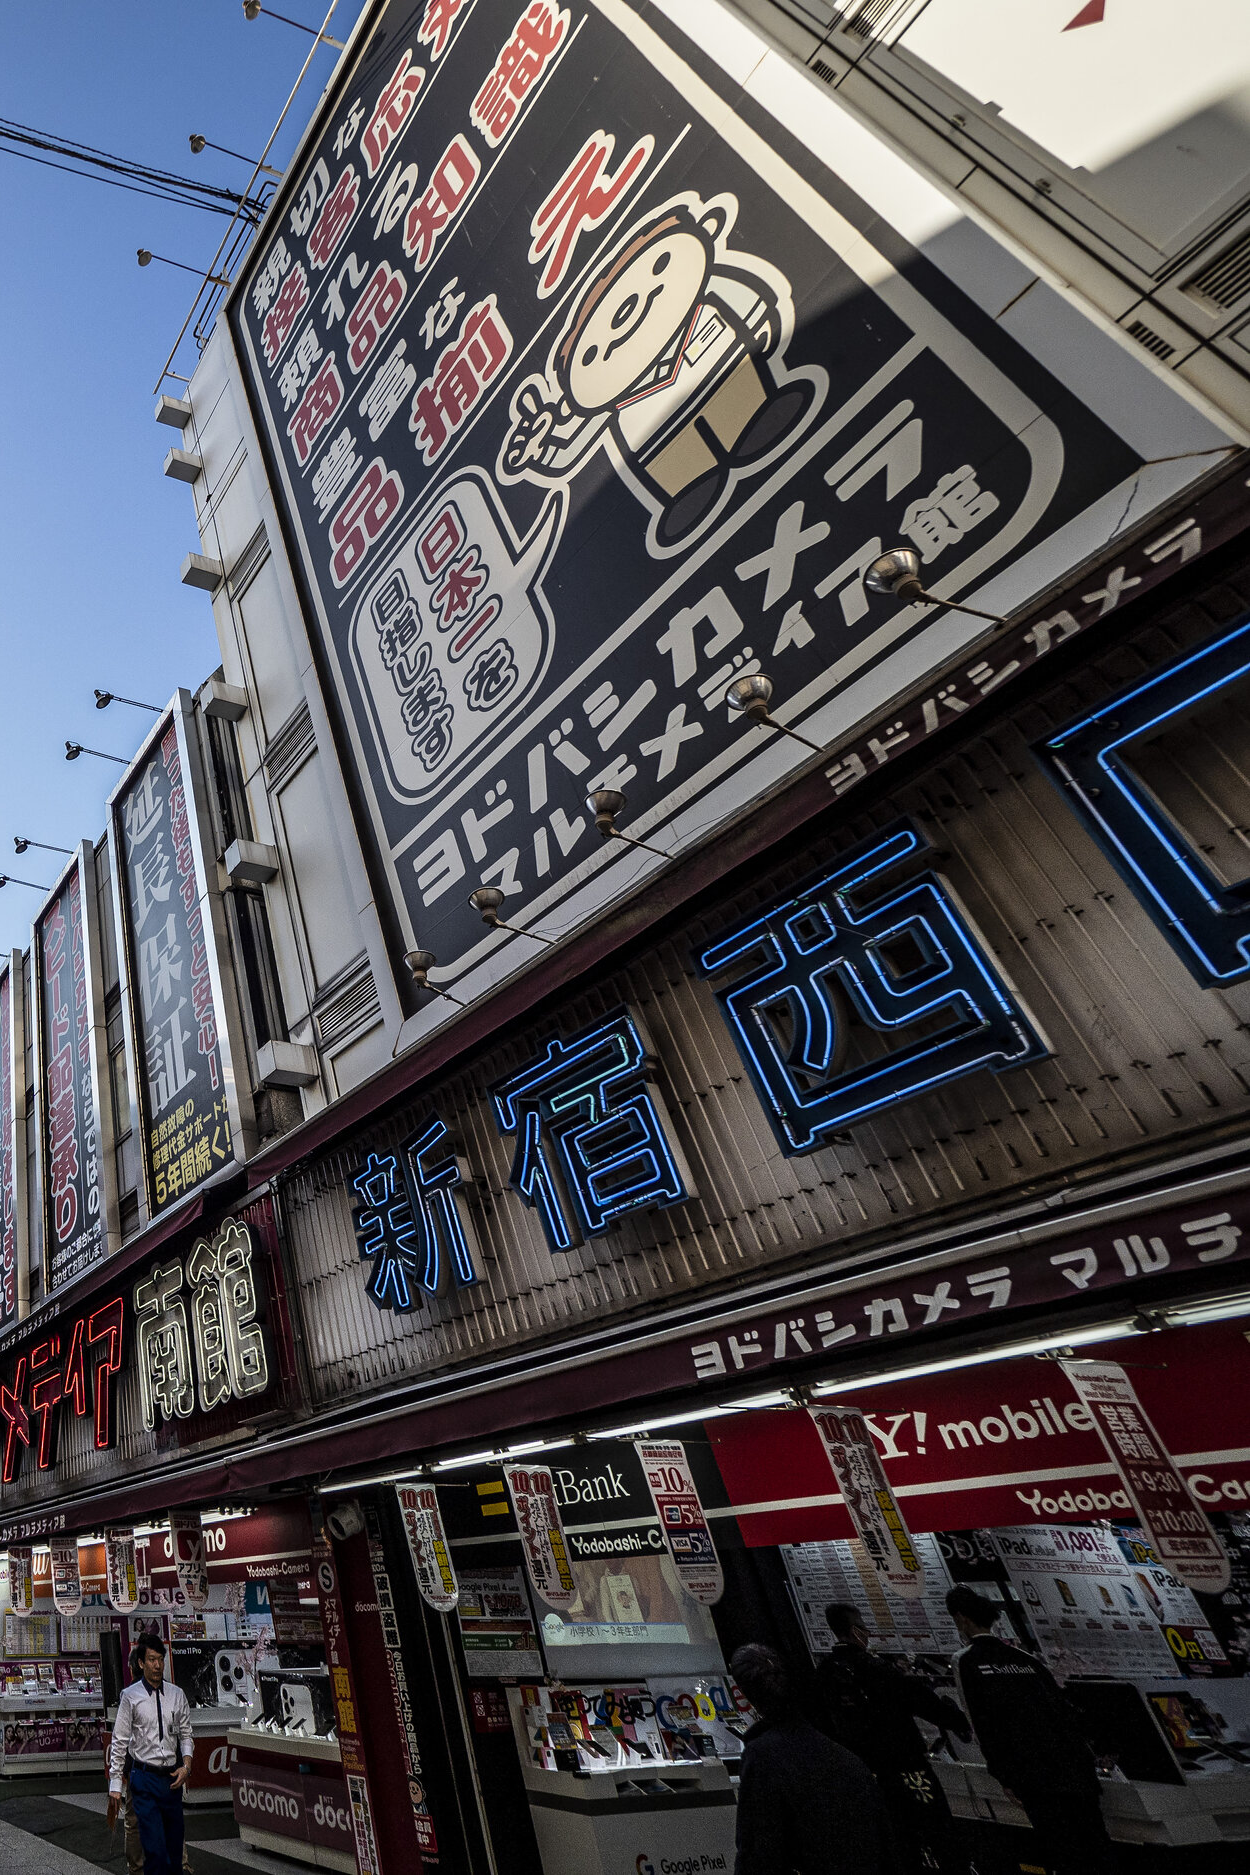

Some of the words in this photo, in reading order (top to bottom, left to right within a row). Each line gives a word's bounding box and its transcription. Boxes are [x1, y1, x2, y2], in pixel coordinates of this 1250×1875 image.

[252, 98, 365, 319] 親切な
[278, 161, 419, 412] 頼れる
[329, 129, 656, 589] 品揃え
[311, 277, 466, 524] 豊富な
[418, 499, 519, 714] 日本一を
[371, 567, 454, 773] 目指します
[410, 399, 924, 908] ヨドバシカメラ
[825, 517, 1203, 796] ヨドバシカメラ
[124, 762, 198, 1119] 延長保証
[42, 898, 79, 1244] スピード配達承り
[150, 1098, 195, 1149] 自然故障の
[133, 1216, 269, 1433] 南館
[691, 1266, 1014, 1379] ヨドバシカメラ
[864, 1411, 928, 1460] Y!
[937, 1396, 1095, 1452] mobile
[1142, 1470, 1181, 1493] 9:30
[20, 1513, 66, 1538] マルチメディア館
[163, 1527, 227, 1558] dmo
[998, 1534, 1031, 1556] iPad
[1059, 1530, 1100, 1555] 1,081
[1156, 1510, 1206, 1533] 10:00
[245, 1562, 310, 1578] Yodobashi-Camera
[432, 1539, 456, 1594] 総額表示
[547, 1528, 576, 1591] 総額表示
[331, 1666, 358, 1735] 南館
[992, 1664, 1036, 1675] SoftBank
[239, 1779, 300, 1820] docomo
[660, 1856, 700, 1875] Google
[701, 1853, 726, 1871] Pixel
